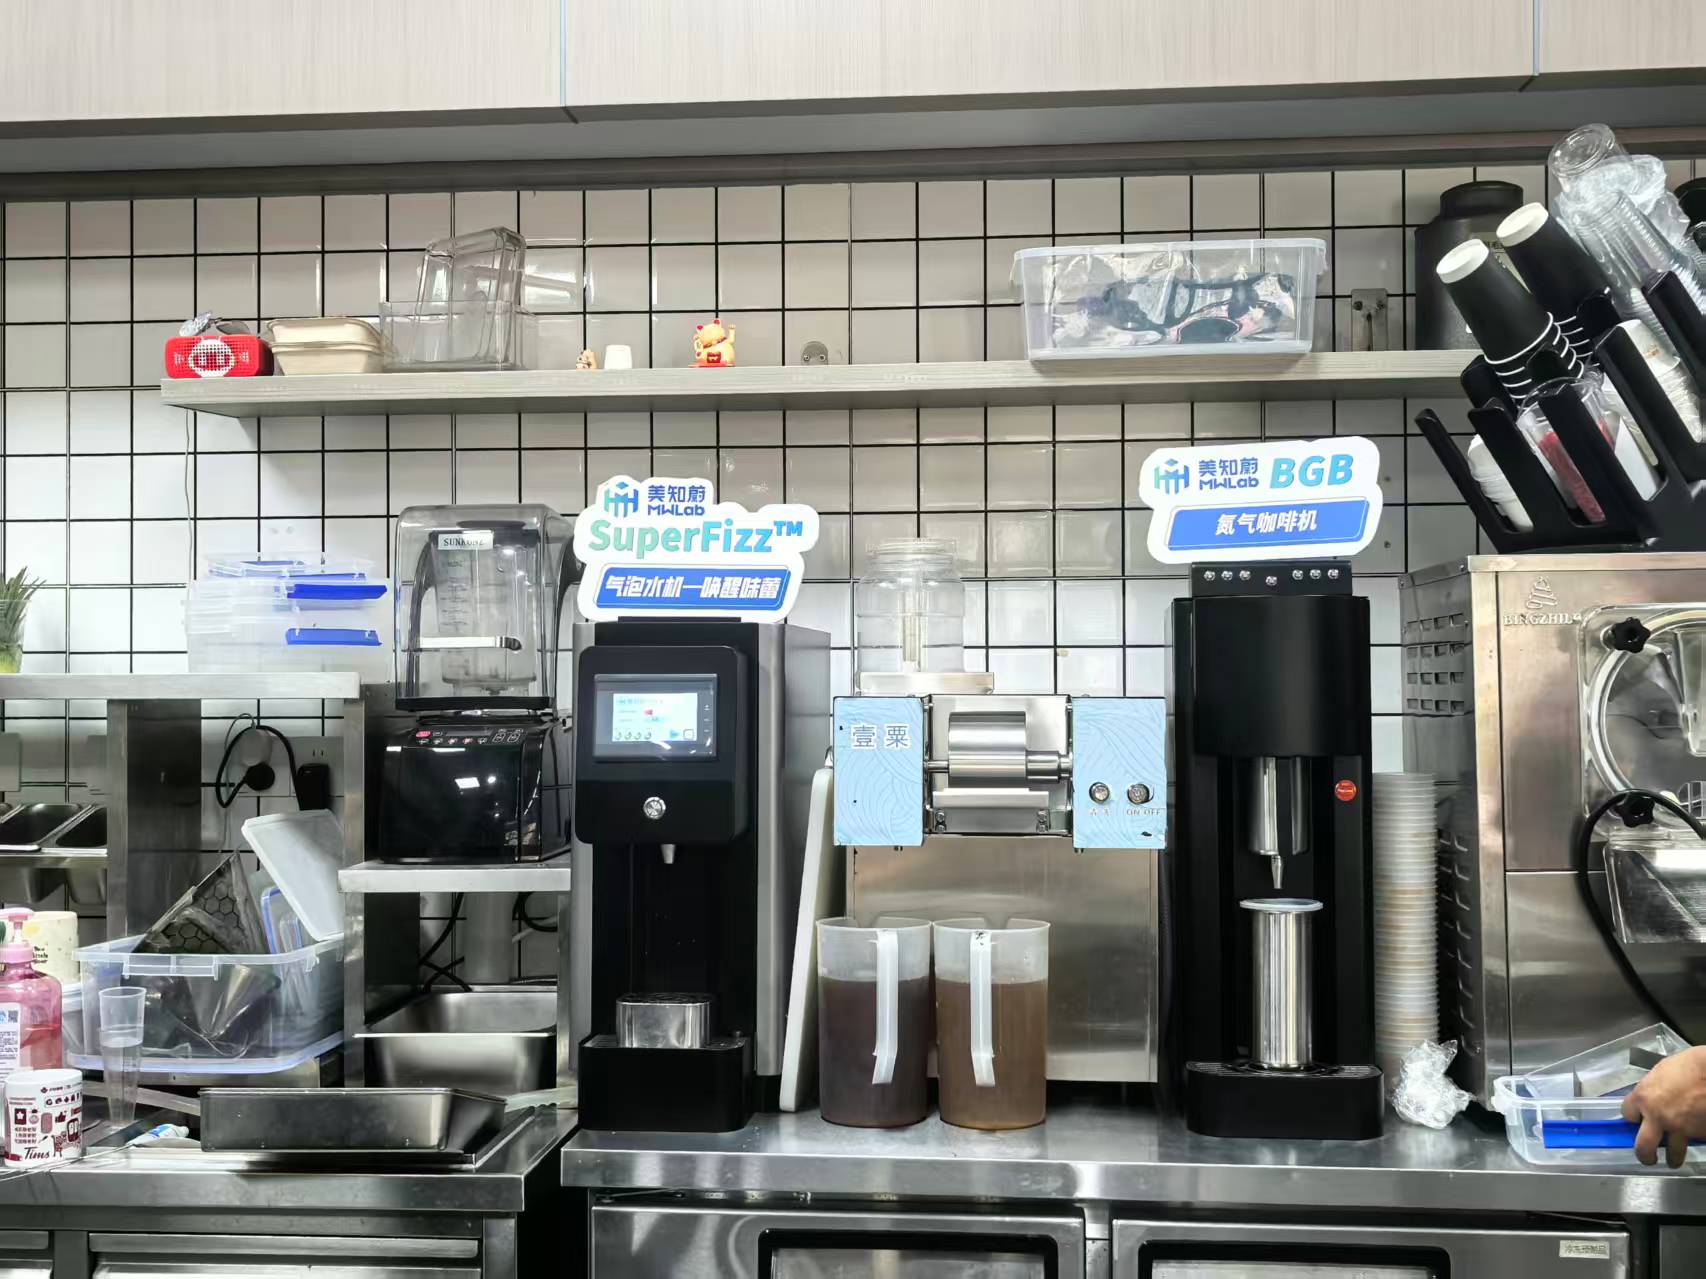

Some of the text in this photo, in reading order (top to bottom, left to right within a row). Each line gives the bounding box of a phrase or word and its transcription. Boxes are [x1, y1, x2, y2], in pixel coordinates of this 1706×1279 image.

[1198, 457, 1259, 477] 美知蔚
[1270, 454, 1354, 489] BGB
[1199, 476, 1260, 491] MWLab
[647, 485, 706, 503] 美知蔚
[647, 504, 706, 516] MWLab
[1215, 509, 1318, 536] 氮气咖啡机
[23, 1146, 50, 1160] Tims
